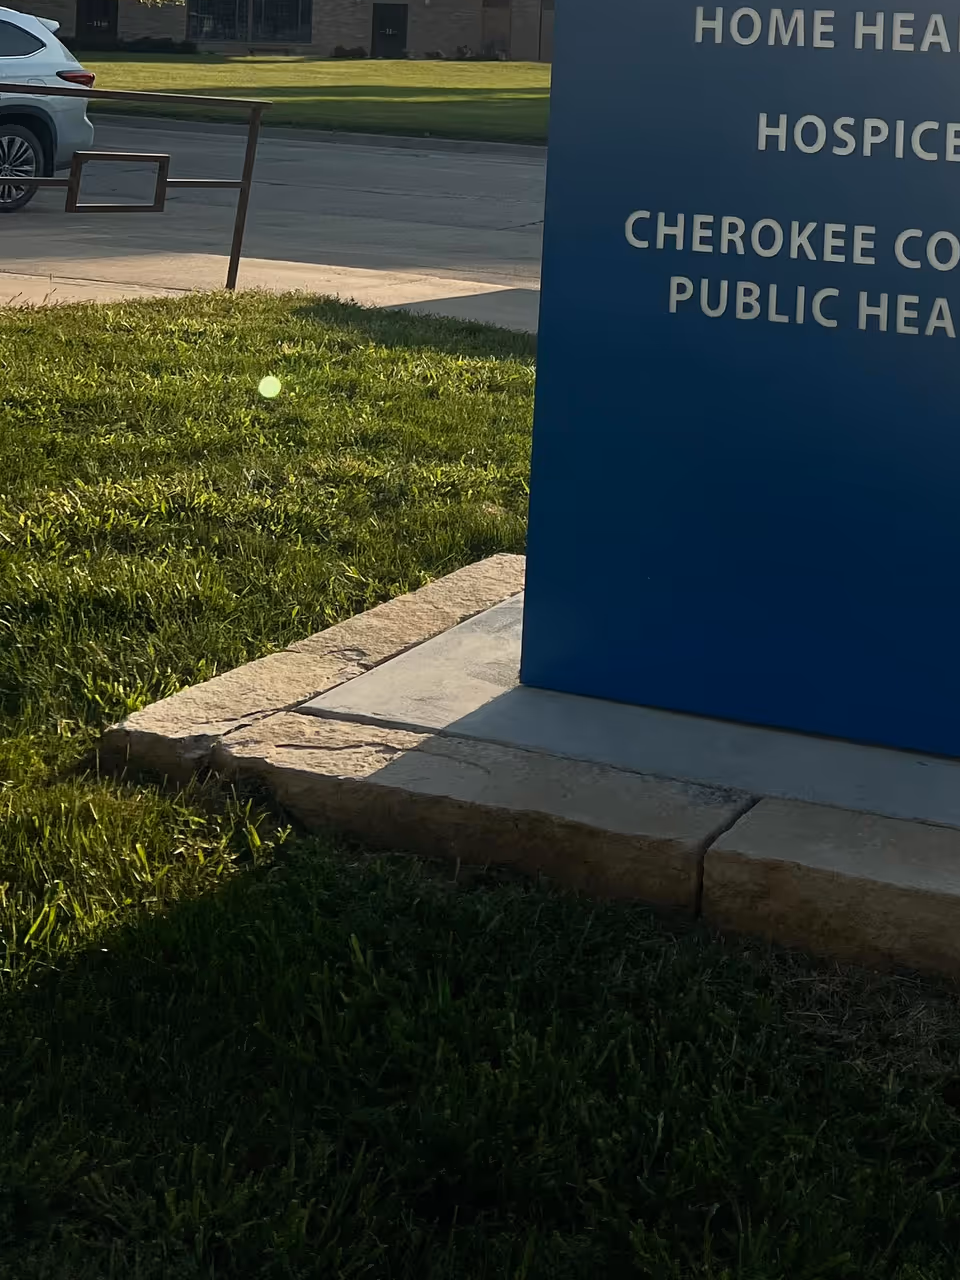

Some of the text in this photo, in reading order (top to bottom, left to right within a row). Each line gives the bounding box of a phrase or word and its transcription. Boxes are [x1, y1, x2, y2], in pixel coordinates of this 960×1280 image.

[694, 6, 836, 49] HOME
[624, 210, 877, 266] CHEROKEE
[667, 276, 840, 329] PUBLIC
